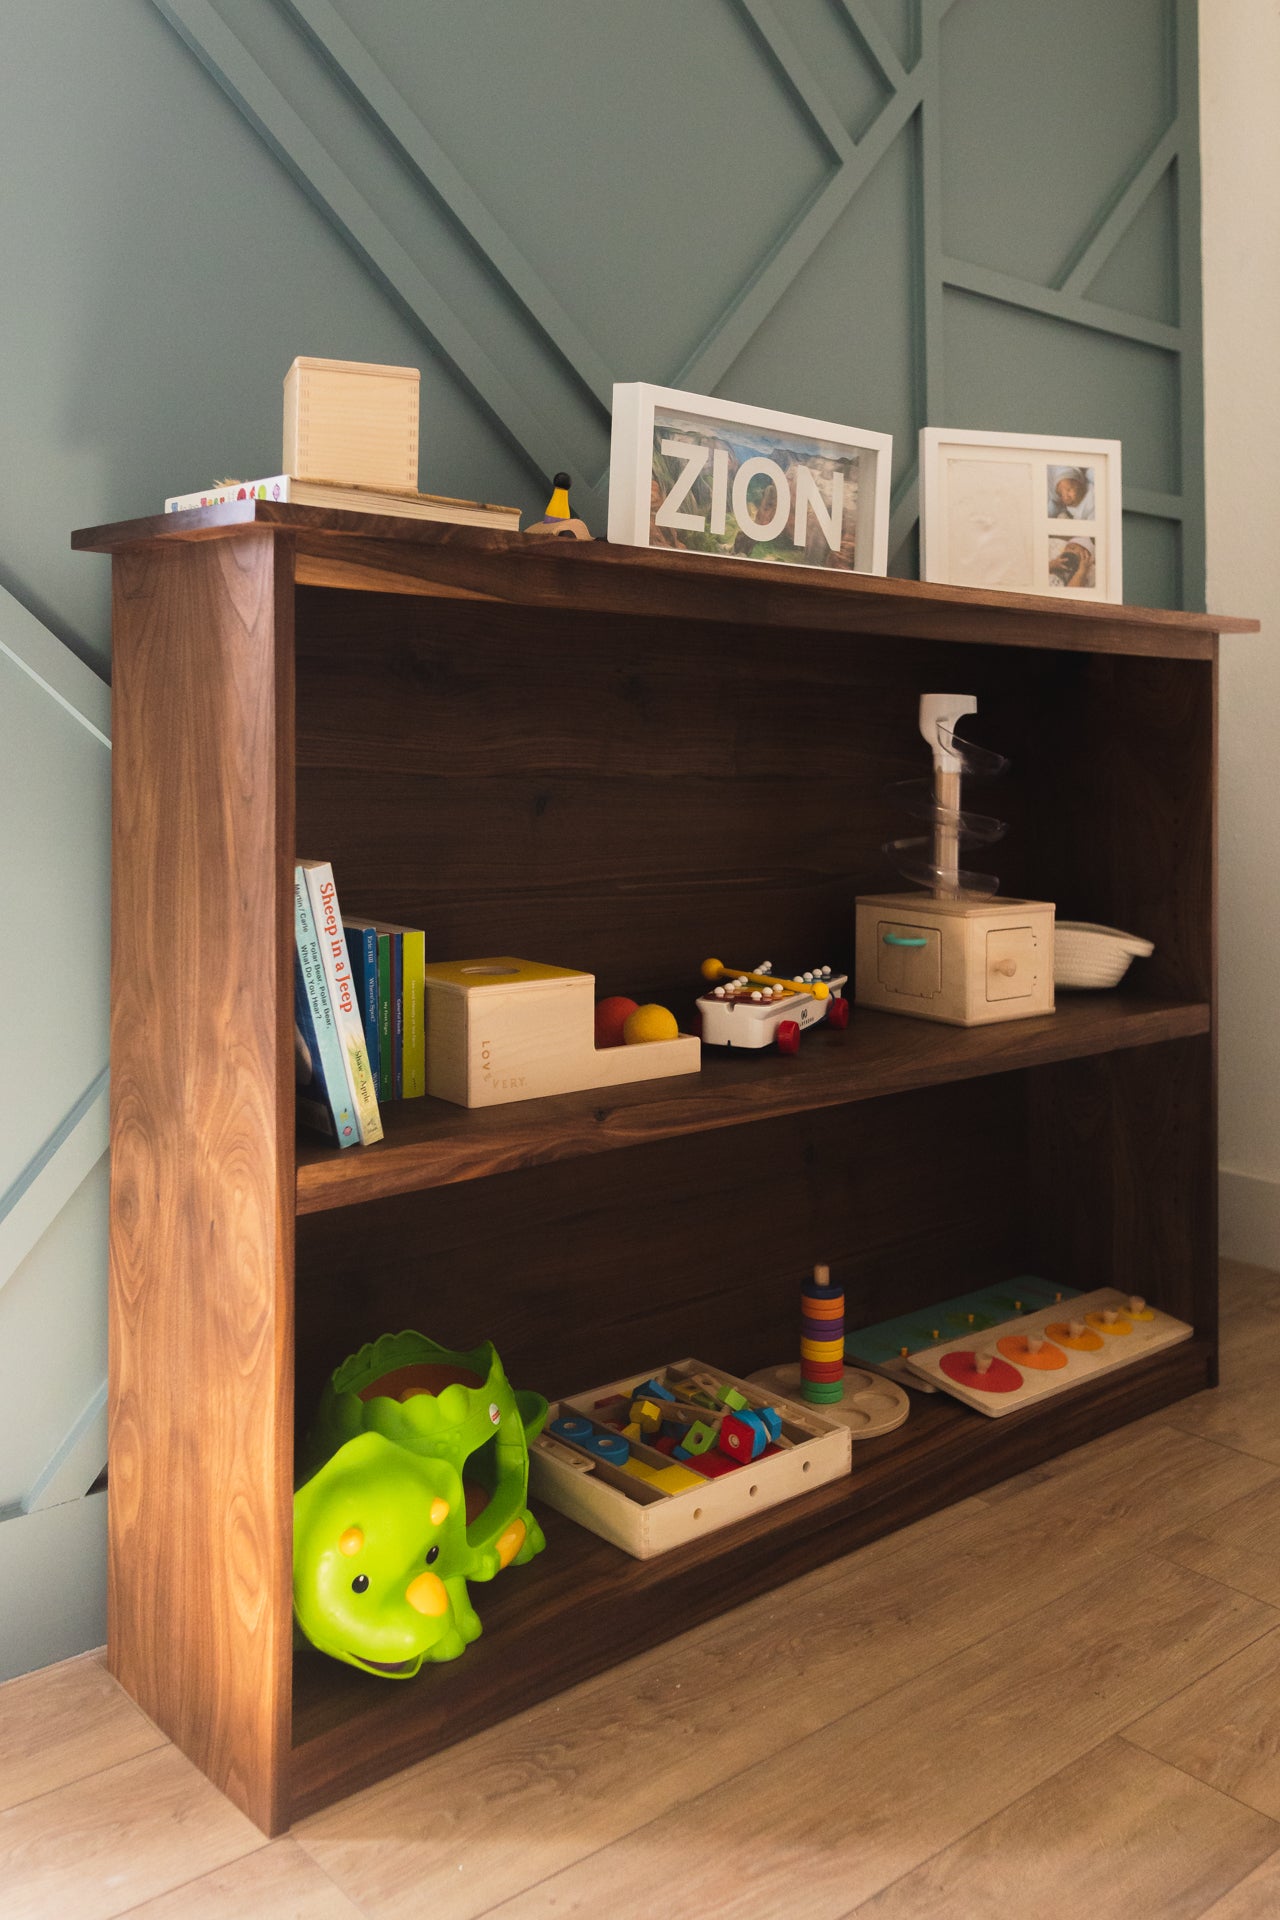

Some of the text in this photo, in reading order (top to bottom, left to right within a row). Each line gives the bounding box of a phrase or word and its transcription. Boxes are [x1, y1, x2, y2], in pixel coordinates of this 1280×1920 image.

[655, 439, 844, 552] ZION
[300, 912, 309, 933] Carle
[320, 882, 353, 1013] Sheep in a Jeep
[301, 944, 321, 1019] What Do You Hear?
[310, 941, 318, 962] Polar
[314, 964, 322, 985] Bear,
[320, 985, 328, 1006] Polar
[355, 1050, 370, 1104] Shaw Apple
